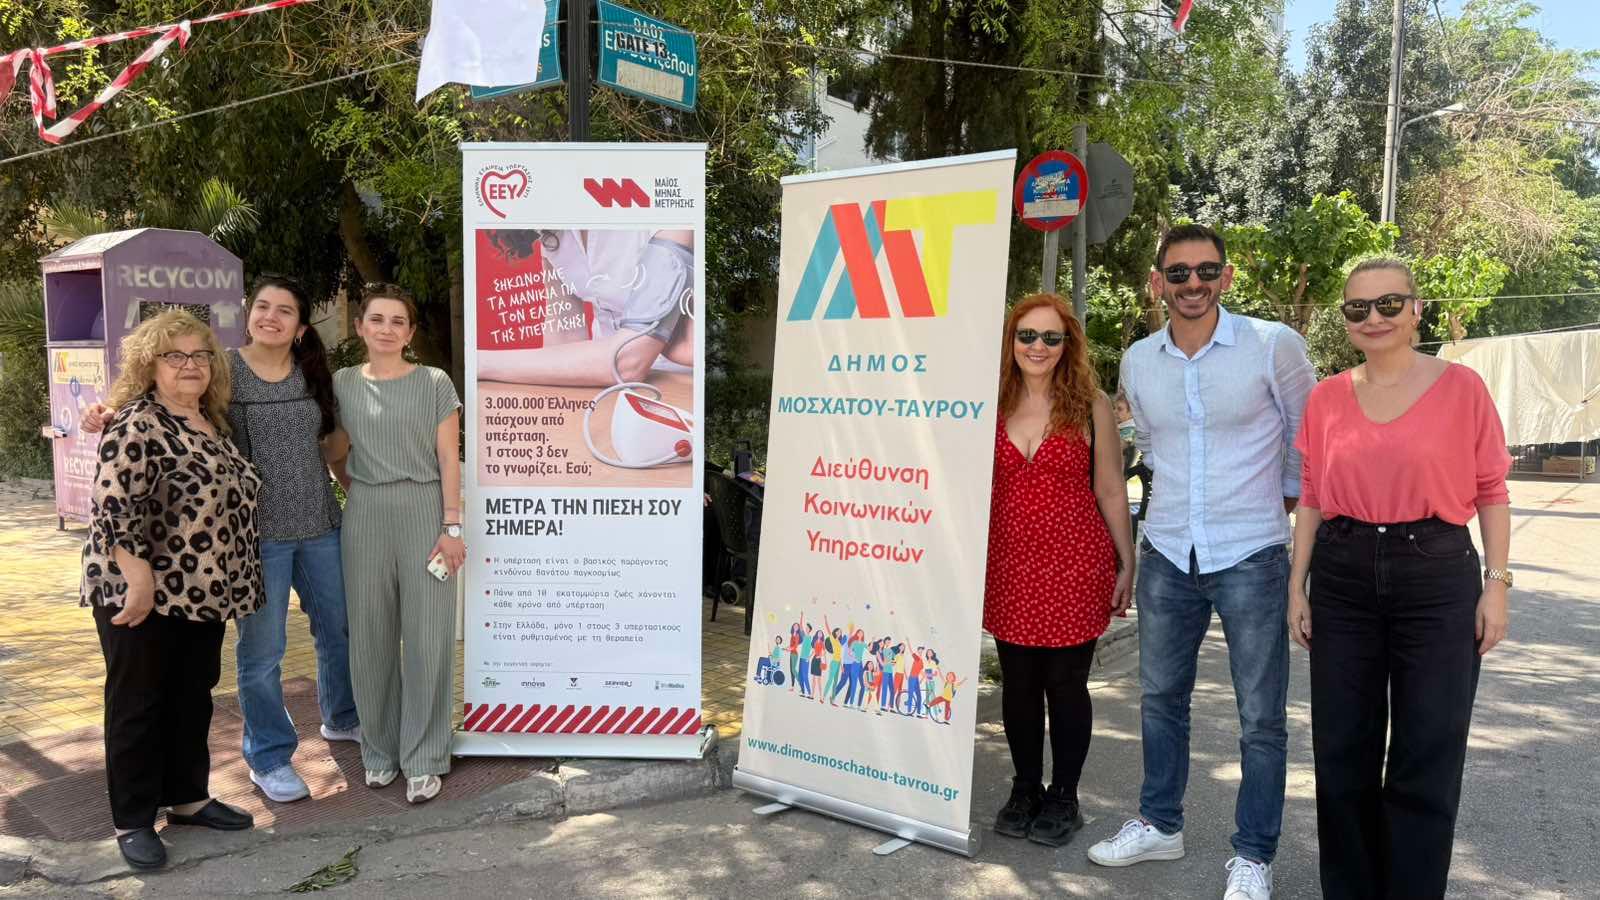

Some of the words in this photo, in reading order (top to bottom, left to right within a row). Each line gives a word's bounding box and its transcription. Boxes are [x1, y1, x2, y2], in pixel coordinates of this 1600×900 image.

[616, 31, 650, 54] GATE
[654, 41, 669, 59] 13
[654, 188, 681, 198] ΜΗΝΑΣ
[654, 198, 695, 208] ΜΕΤΡΗΣΗΣ
[116, 264, 240, 290] RECYCOM
[494, 267, 565, 293] ΣΗΚΩΝΟΥΜΕ
[487, 295, 506, 311] ΤΑ
[509, 286, 559, 307] ΜΑΝΙΚΙΑ
[498, 310, 526, 325] ΤΟΝ
[530, 301, 572, 320] ΕΛΕΓΧΟ
[490, 329, 516, 344] ΤΗΣ
[518, 312, 586, 341] ΥΠΕΡΤΑΣΗΣ!
[827, 354, 928, 373] ΔΗΜΟΣ
[485, 397, 544, 410] 3.000.000
[544, 396, 596, 412] Έλληνες
[777, 396, 985, 420] ΜΟΣΧΑΤΟΥ-ΤΑΥΡΟΥ
[485, 413, 538, 429] πάσχουν
[541, 413, 565, 426] από
[485, 430, 550, 445] υπέρταση.
[486, 446, 492, 458] 1
[496, 447, 533, 461] στους
[536, 446, 543, 458] 3
[546, 446, 569, 458] δεν
[485, 465, 500, 474] το
[503, 462, 562, 477] γνωρίζει.
[566, 461, 592, 476] Εσύ;
[810, 455, 929, 490] Διεύθυνση
[485, 498, 546, 515] ΜΕΤΡΑ
[551, 498, 588, 515] ΤΗΝ
[592, 499, 643, 516] ΠΙΕΣΗ
[648, 499, 682, 516] ΣΟΥ
[803, 492, 932, 524] Κοινωνικών
[485, 519, 564, 537] ΣΗΜΕΡΑ!
[806, 530, 924, 564] Υπηρεσιών
[503, 557, 541, 566] υπέρταση
[545, 557, 569, 565] είναι
[494, 567, 532, 577] κινδύνου
[493, 621, 512, 631] Στην
[586, 623, 612, 632] στους
[614, 622, 621, 631] 3
[746, 736, 960, 801] www.dimosmoschatou-tavrou.gr
